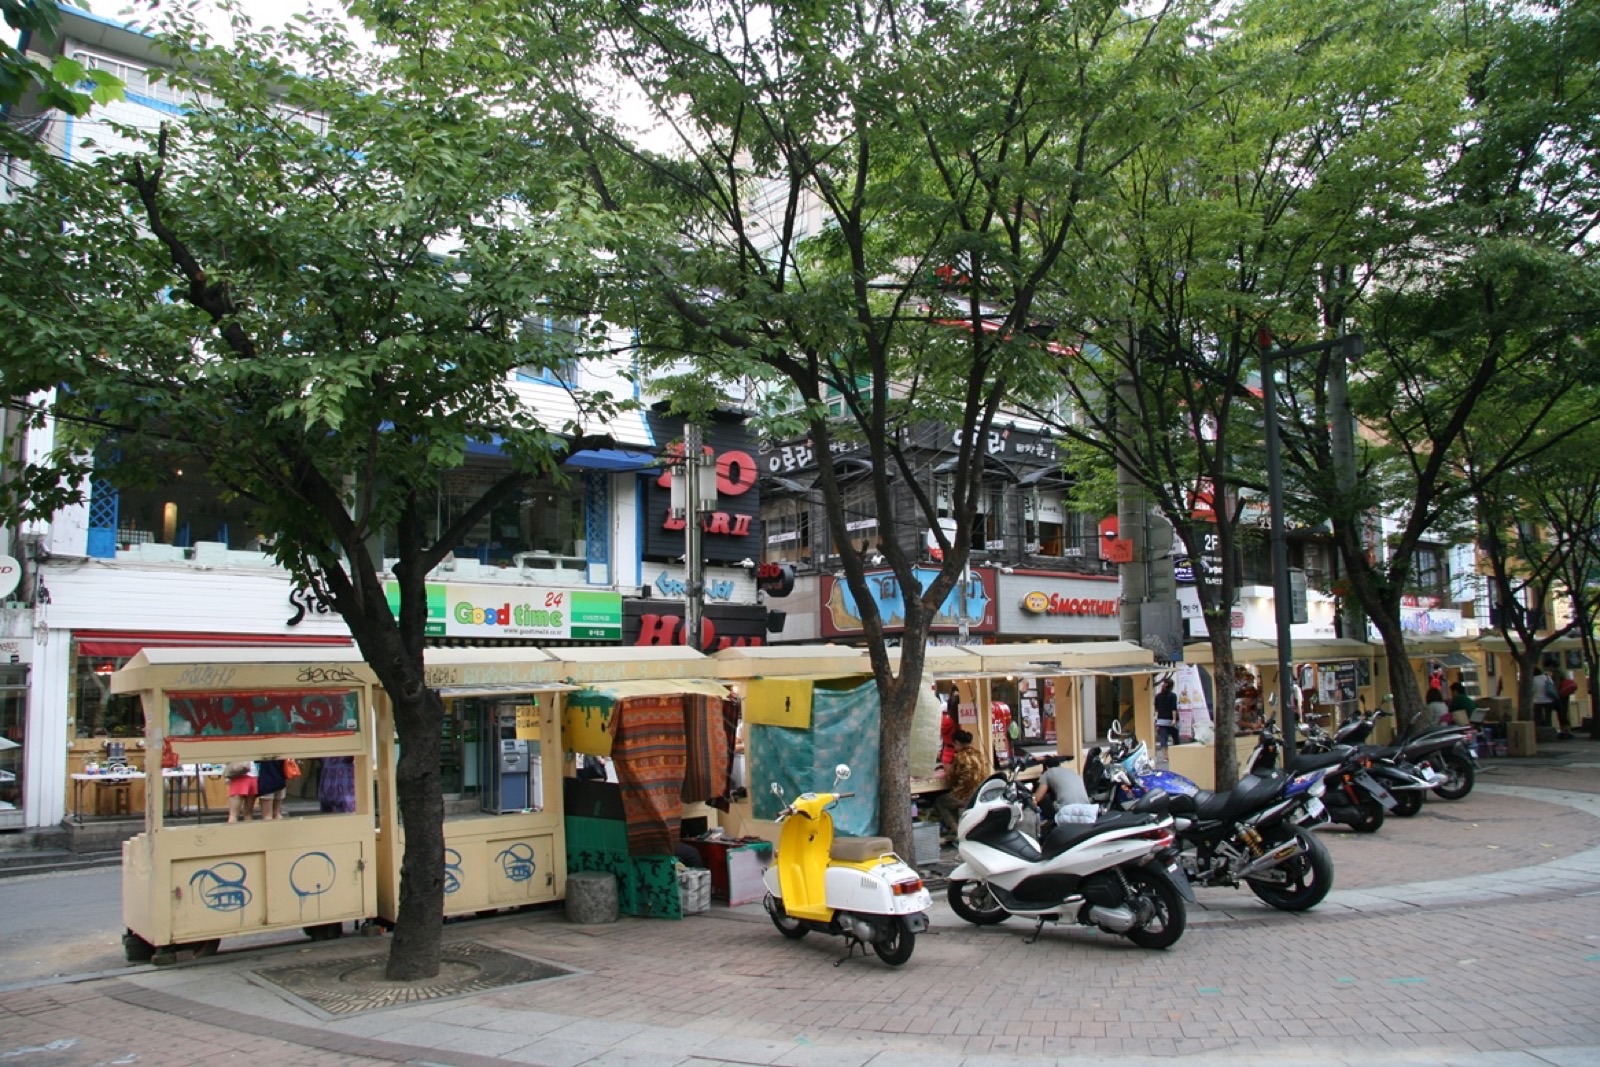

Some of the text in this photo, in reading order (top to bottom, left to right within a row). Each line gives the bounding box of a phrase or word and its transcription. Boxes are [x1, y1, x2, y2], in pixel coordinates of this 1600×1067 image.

[544, 591, 564, 608] 24
[454, 601, 564, 628] Good time
